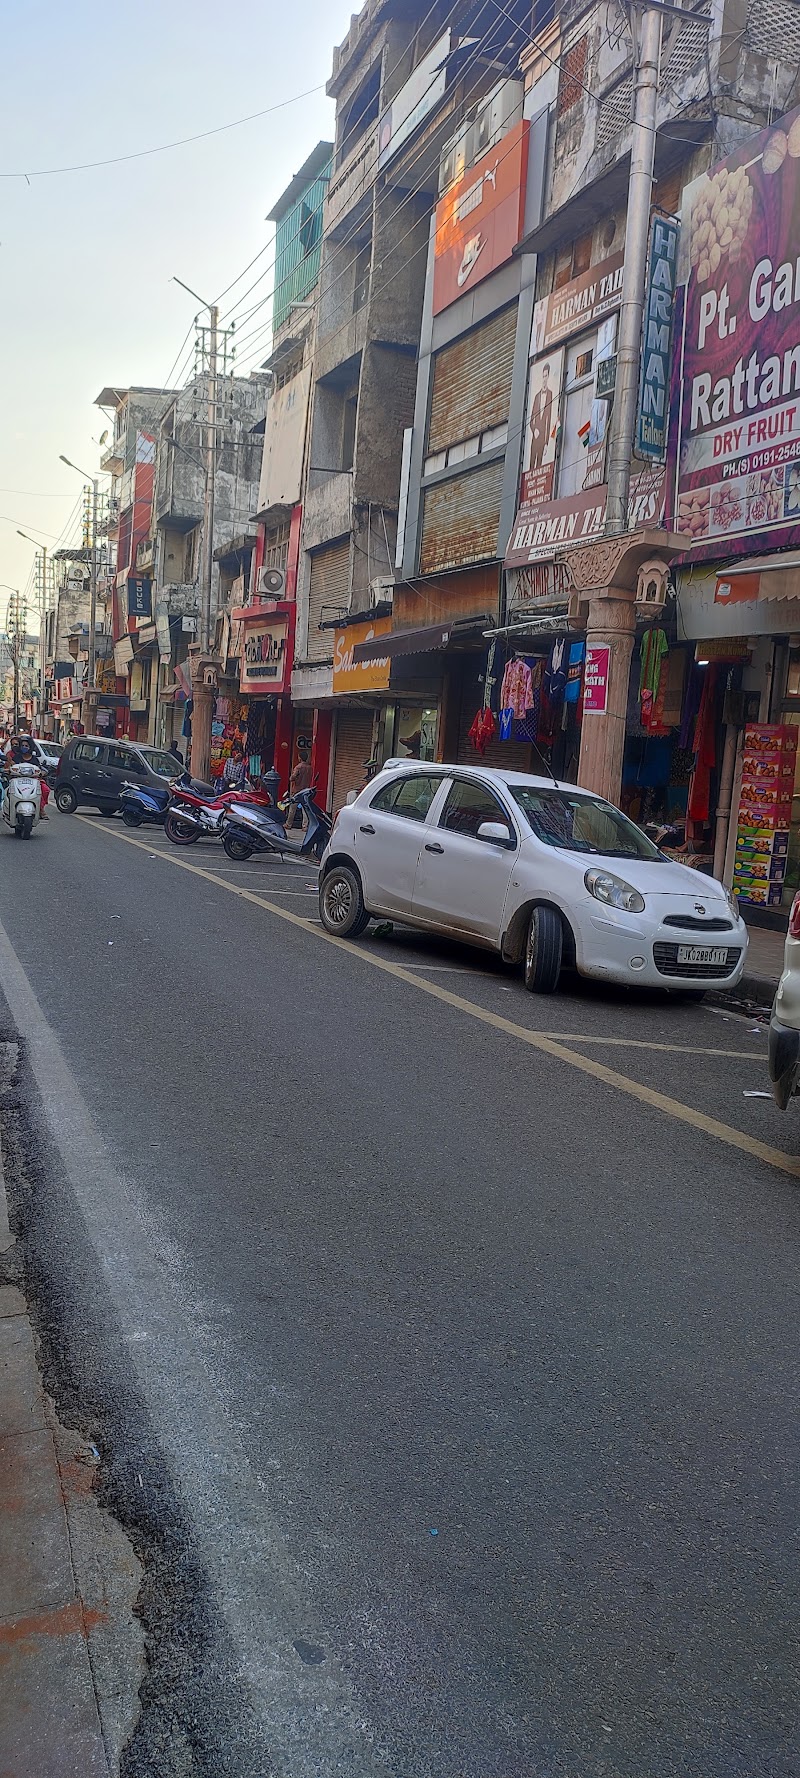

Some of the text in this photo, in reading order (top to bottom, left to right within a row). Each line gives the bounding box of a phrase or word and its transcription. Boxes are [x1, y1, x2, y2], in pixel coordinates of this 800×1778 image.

[551, 283, 597, 327] HARMAN
[643, 224, 676, 417] HARMAN
[698, 283, 737, 350] Pt.
[713, 407, 797, 458] DRY FRUIT
[722, 457, 750, 478] PH.(S)
[511, 512, 580, 550] HARMAN
